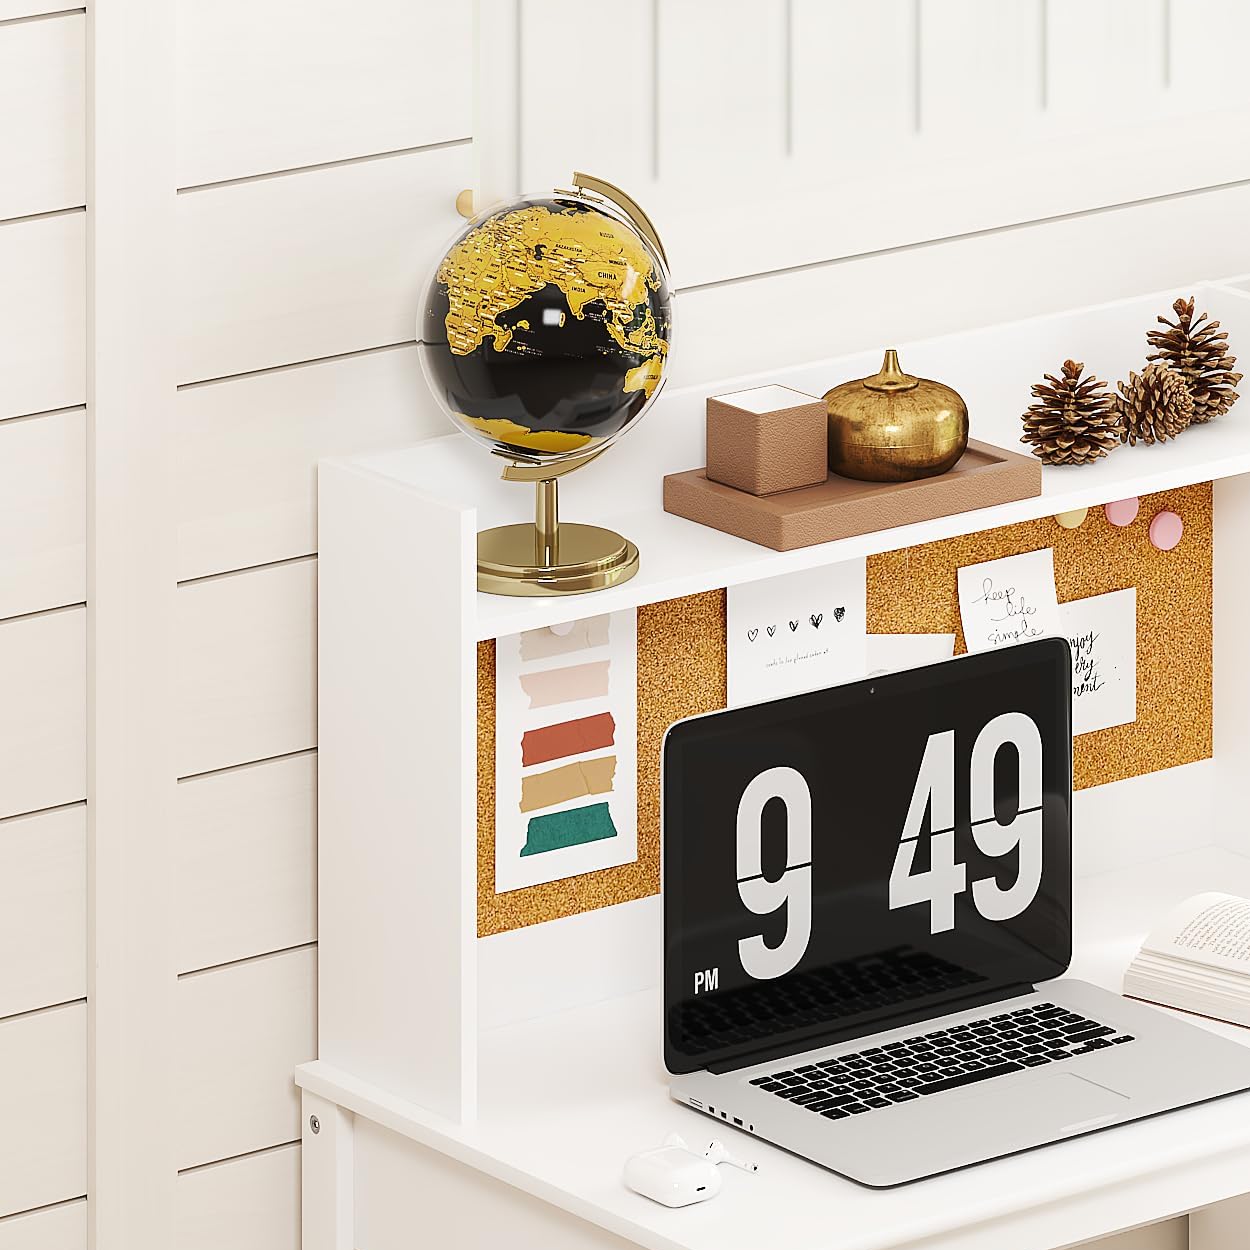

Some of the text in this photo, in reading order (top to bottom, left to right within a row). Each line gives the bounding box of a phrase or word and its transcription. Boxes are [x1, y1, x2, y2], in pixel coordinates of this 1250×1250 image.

[597, 271, 618, 281] CHINA
[971, 577, 1016, 604] keep
[990, 596, 1037, 622] life
[987, 619, 1044, 645] simple
[1069, 630, 1101, 661] njoy
[1074, 656, 1100, 682] ery
[736, 711, 1043, 980] 9 49
[694, 967, 719, 995] PM
